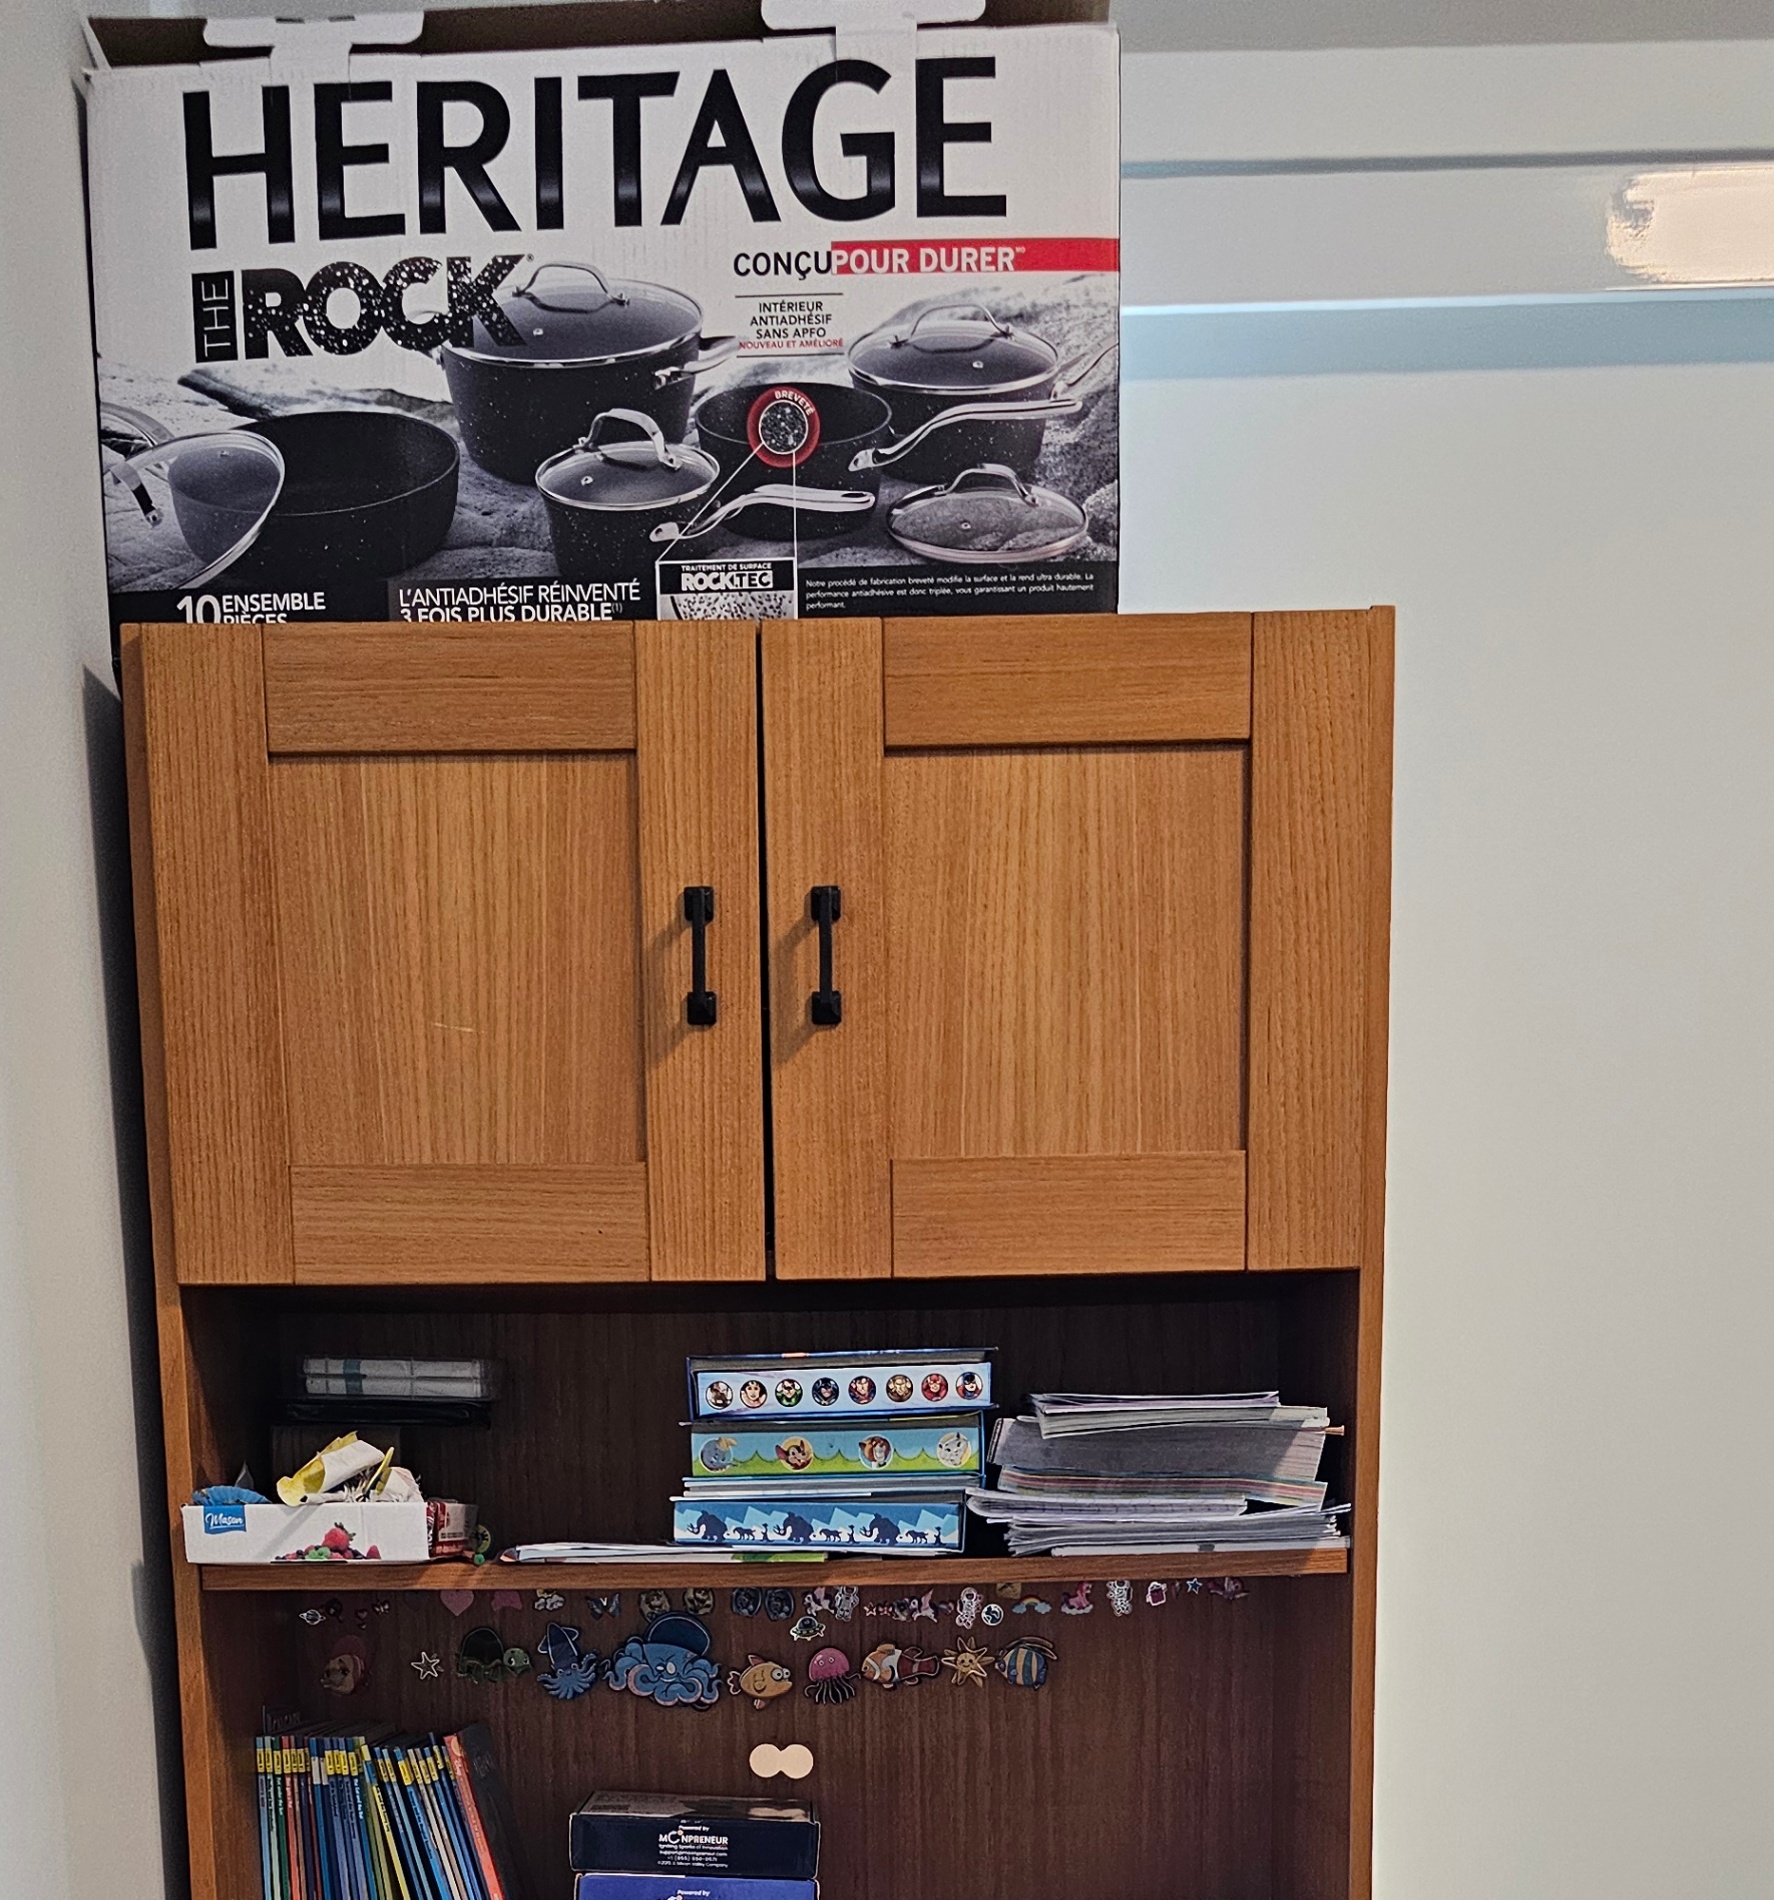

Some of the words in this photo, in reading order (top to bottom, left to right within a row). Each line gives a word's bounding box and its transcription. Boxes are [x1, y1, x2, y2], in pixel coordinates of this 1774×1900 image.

[182, 56, 1008, 252] HERITAGE
[733, 250, 832, 280] CONÇU
[831, 247, 909, 275] POUR
[758, 299, 823, 313] INTÉRIEUR
[201, 277, 230, 357] THE
[749, 311, 833, 327] ANTIADHÉSIF
[756, 328, 790, 340] SANS
[794, 327, 826, 339] APFO
[738, 339, 784, 350] NOUVEAU
[786, 339, 796, 349] ET
[799, 337, 844, 349] AMÉLIORÉ
[681, 564, 726, 572] TRAITEMENT
[728, 563, 738, 571] DE
[739, 562, 772, 570] SURFACE
[806, 580, 826, 588] Notre
[870, 576, 906, 586] fabrication
[965, 574, 971, 583] la
[974, 573, 998, 583] surface
[1000, 574, 1008, 582] et
[1010, 573, 1016, 582] la
[1018, 573, 1034, 582] rend
[1036, 572, 1052, 581] ultra
[538, 578, 641, 604] RÉINVENTÉ
[806, 590, 849, 599] performance
[897, 588, 907, 596] est
[909, 587, 926, 596] donc
[955, 586, 972, 594] vous
[974, 585, 1015, 595] garantissant
[1029, 583, 1054, 594] produit
[1056, 583, 1094, 592] hautement
[176, 594, 222, 624] 10
[222, 592, 326, 613] ENSEMBLE
[417, 606, 462, 622] FOIS
[468, 605, 515, 622] PLUS
[205, 1513, 243, 1528] Mason
